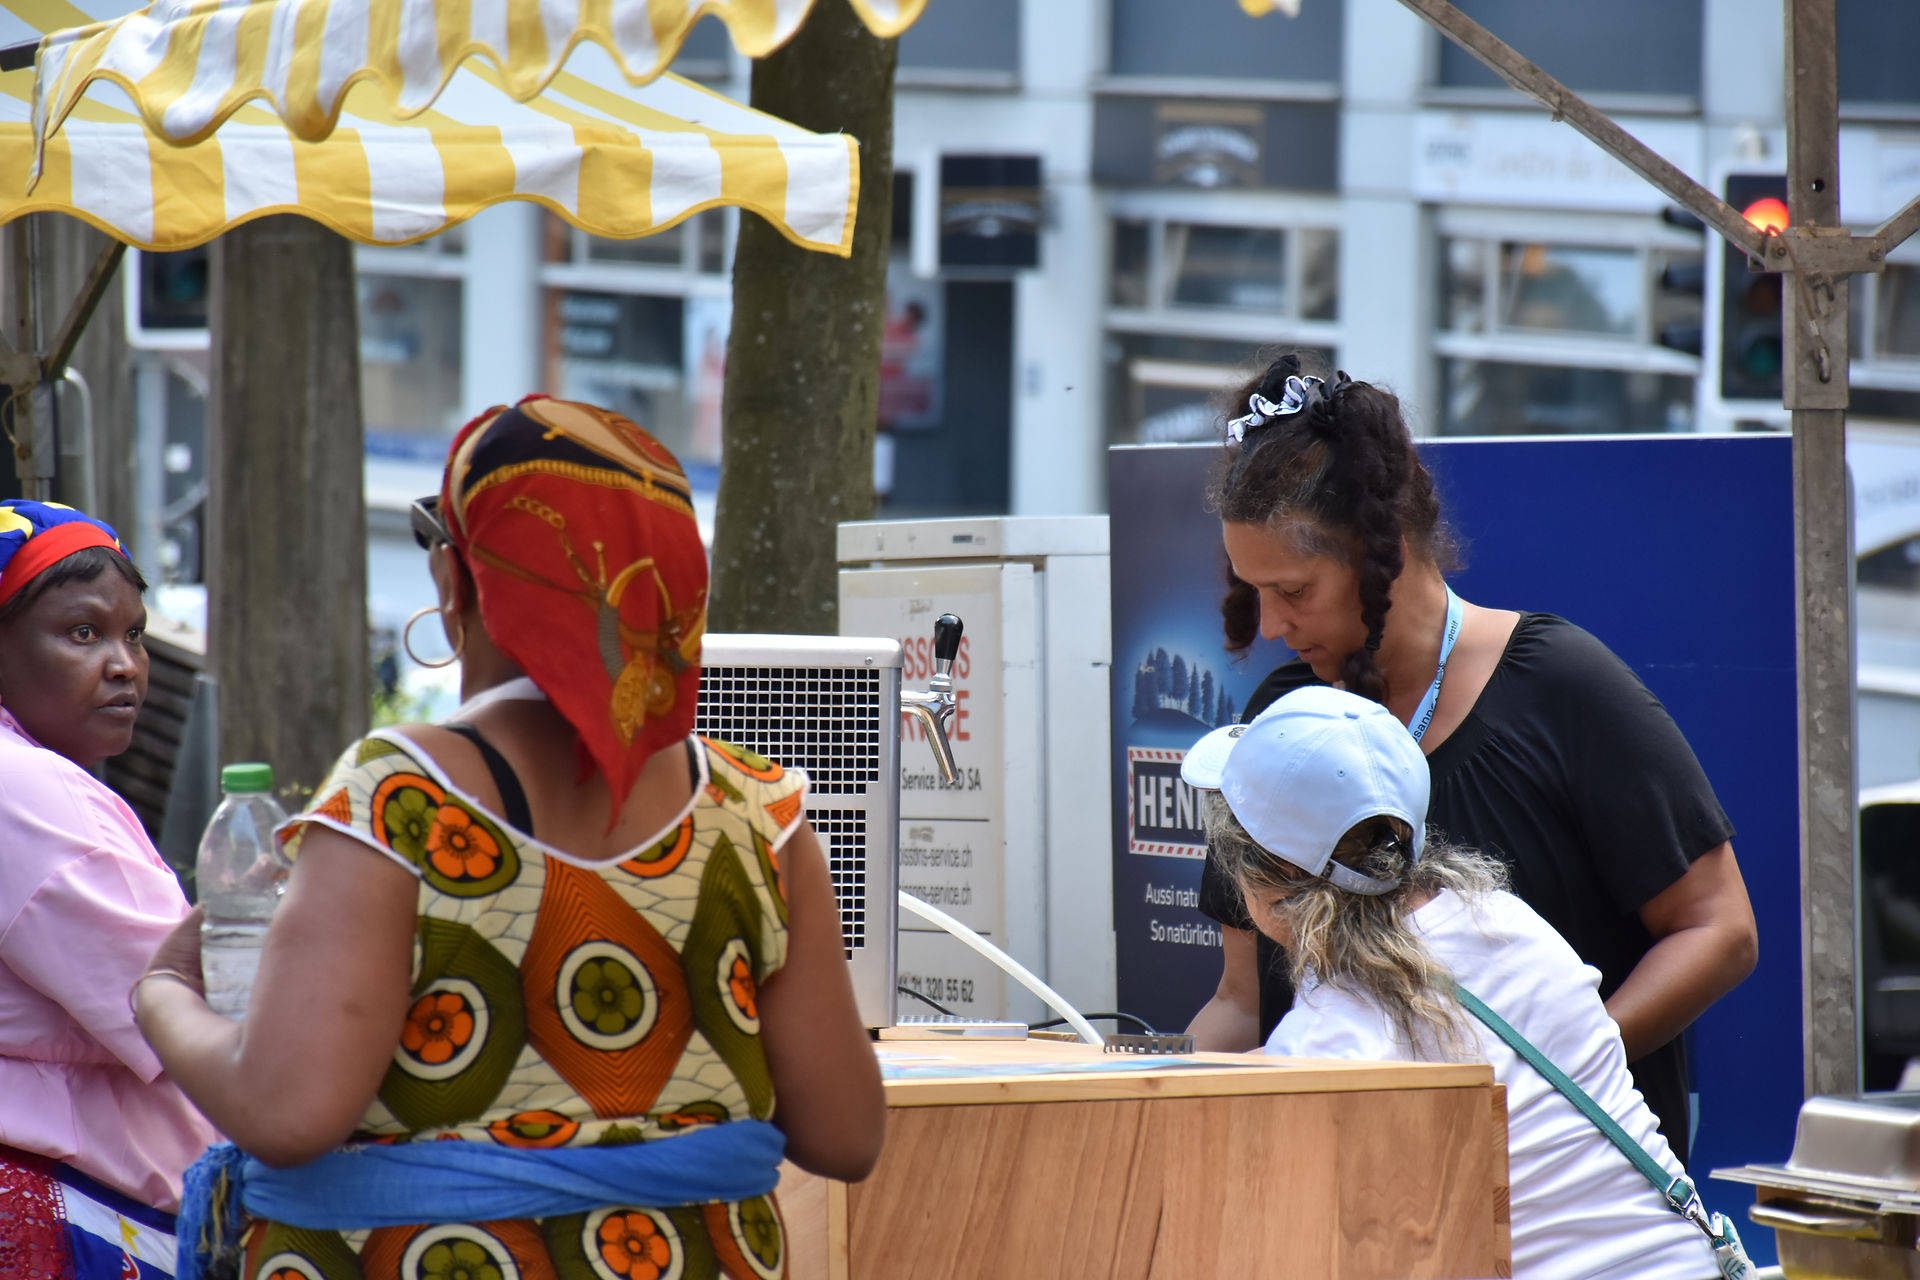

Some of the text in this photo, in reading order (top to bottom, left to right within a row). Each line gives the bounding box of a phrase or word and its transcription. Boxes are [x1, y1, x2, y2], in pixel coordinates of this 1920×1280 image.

[902, 767, 935, 791] Service
[968, 767, 982, 791] SA
[1145, 882, 1175, 906] Aussi
[1150, 919, 1166, 942] So
[1167, 922, 1216, 947] natürlich
[946, 978, 958, 1002] 55
[961, 979, 974, 1003] 62
